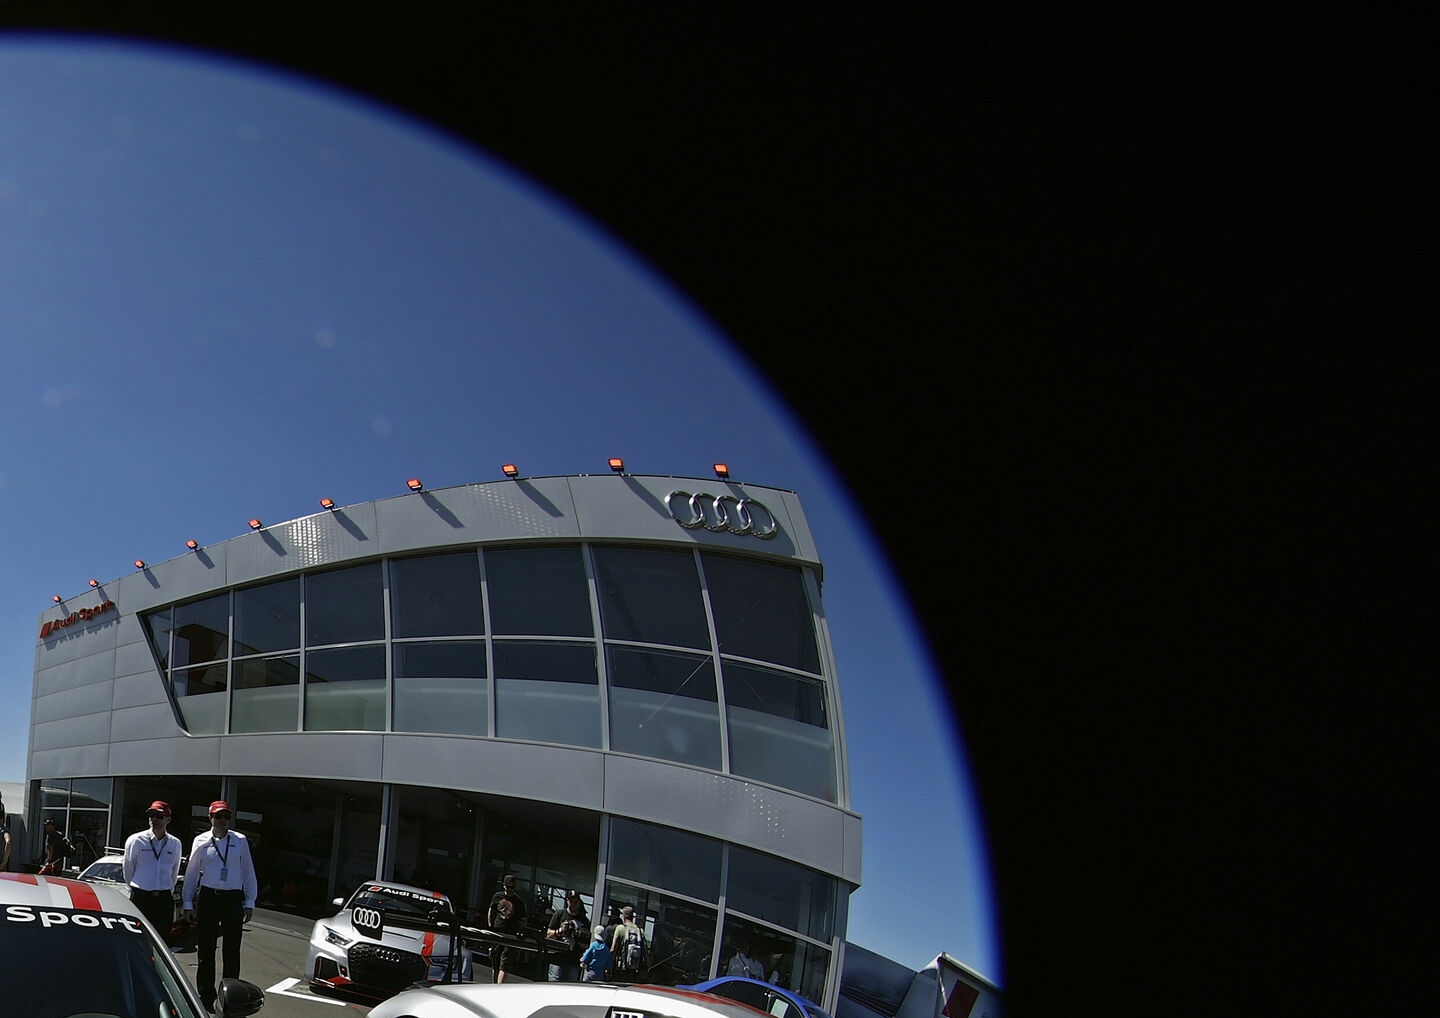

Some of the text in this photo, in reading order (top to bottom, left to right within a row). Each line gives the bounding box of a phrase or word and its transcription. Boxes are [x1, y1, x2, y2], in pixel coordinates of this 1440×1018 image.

[52, 600, 115, 630] Audi Sport
[383, 888, 444, 906] Audi Sport
[6, 907, 143, 935] Sport
